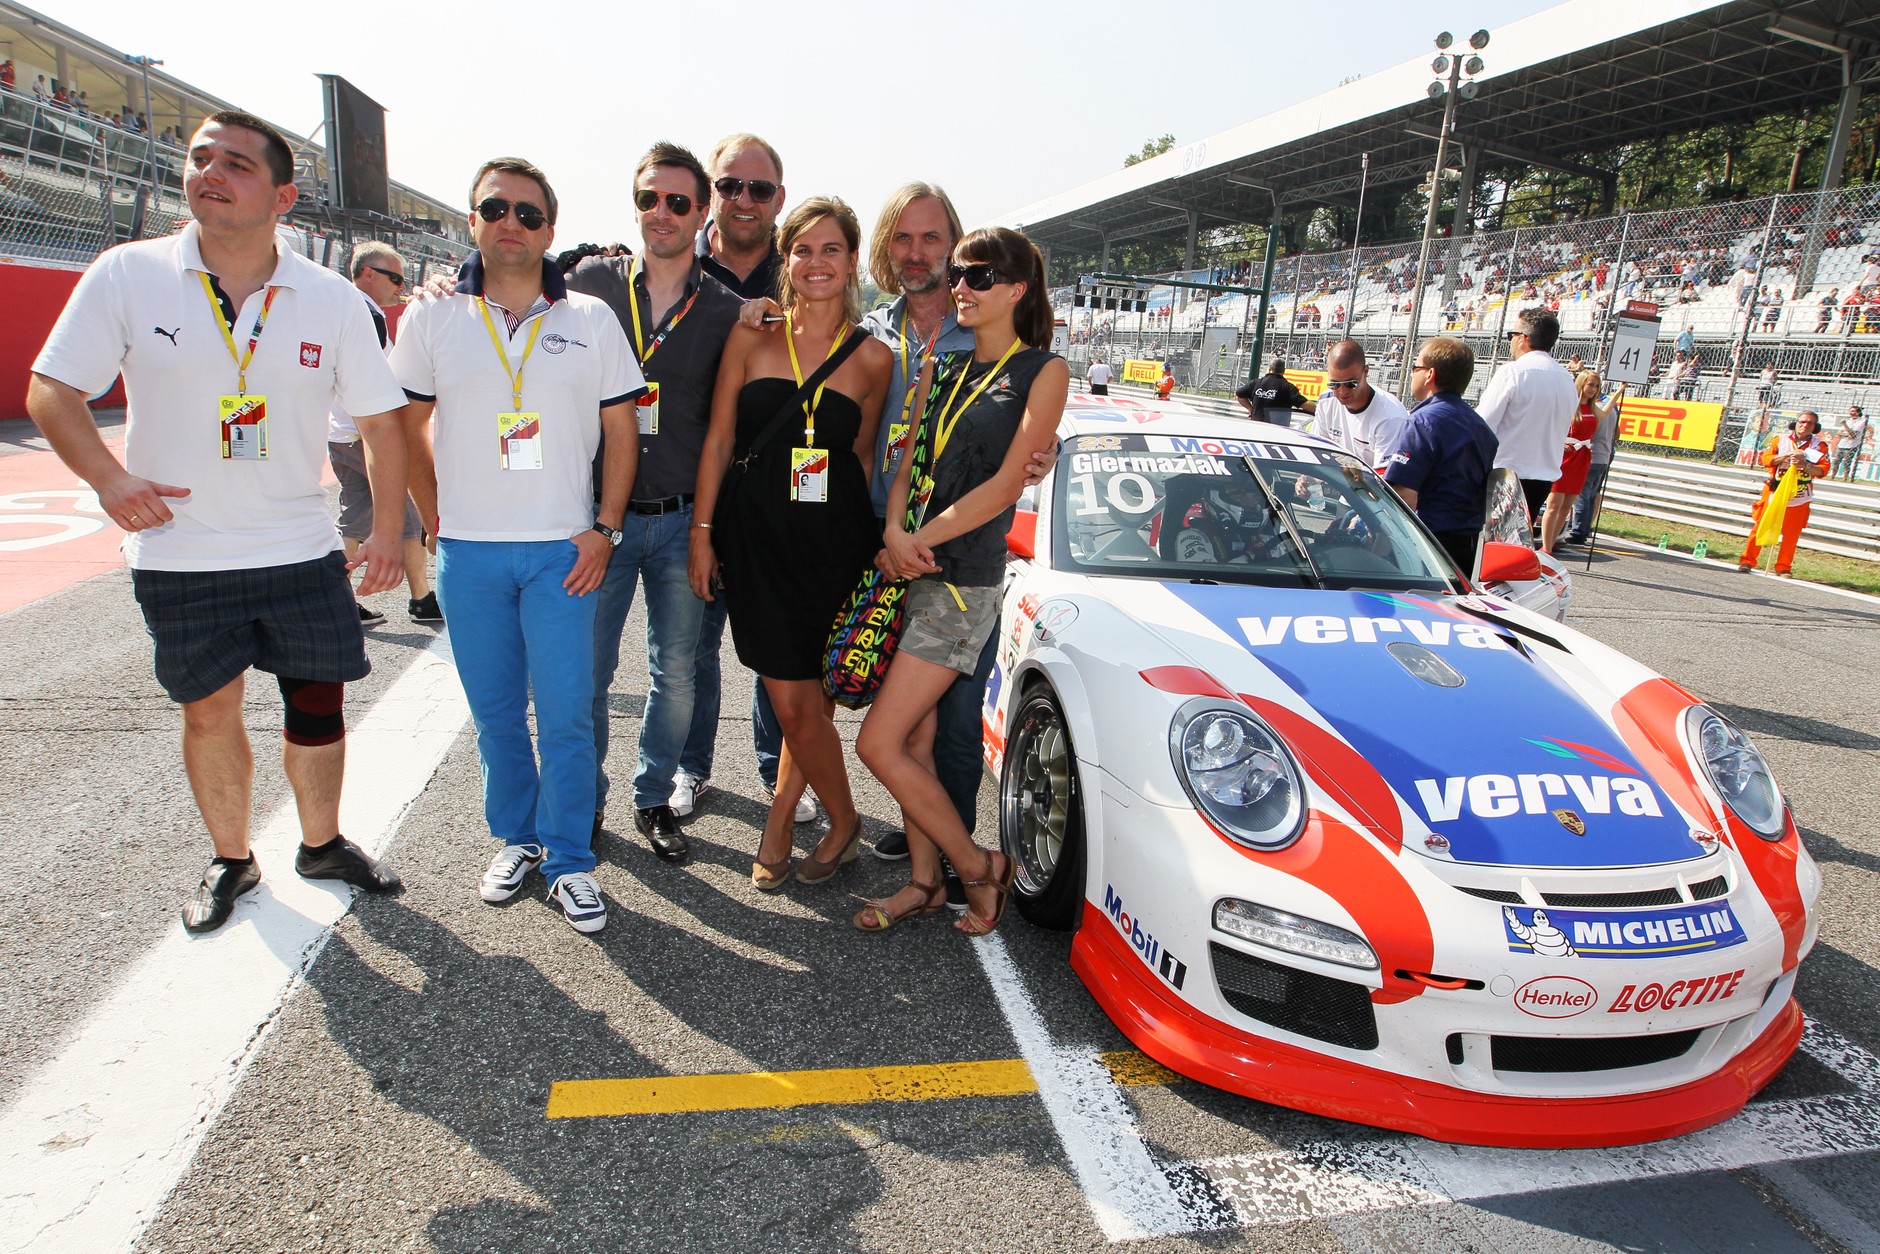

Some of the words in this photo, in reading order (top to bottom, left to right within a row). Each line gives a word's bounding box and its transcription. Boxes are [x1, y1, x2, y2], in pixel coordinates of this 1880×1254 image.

[1635, 305, 1656, 313] Santander
[1055, 336, 1060, 346] 9
[1130, 362, 1156, 380] PIRELLI
[1619, 347, 1640, 371] 41
[1170, 437, 1262, 457] Mobil
[1072, 453, 1232, 476] Giermaziak
[1070, 472, 1156, 516] 10
[1237, 615, 1510, 651] verva
[1414, 773, 1664, 823] verva
[1104, 883, 1159, 967] Mobil
[1573, 909, 1733, 945] MICHELIN
[1521, 988, 1591, 1007] Henkel
[1607, 969, 1745, 1013] LOCTITE
